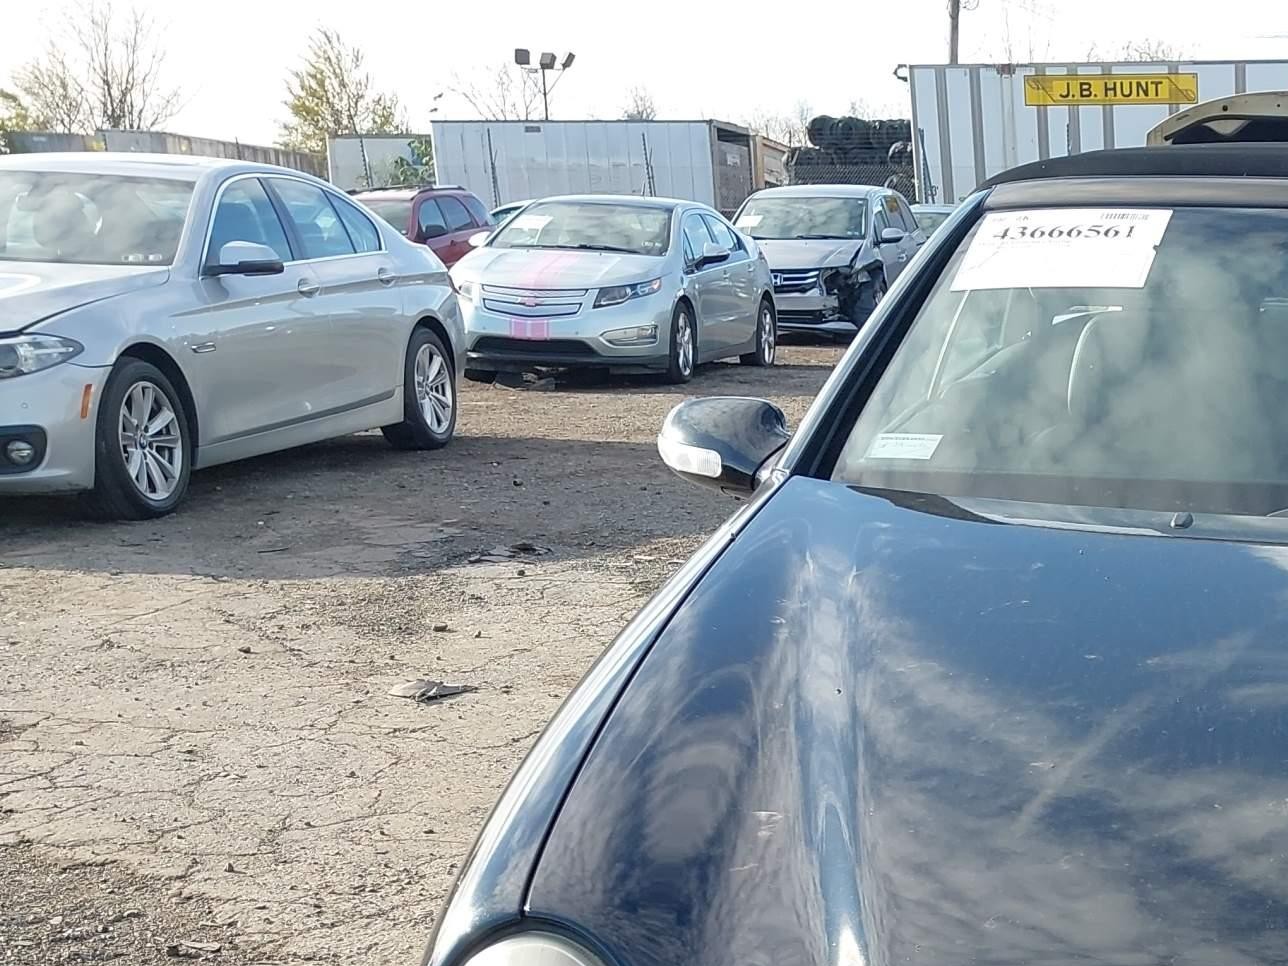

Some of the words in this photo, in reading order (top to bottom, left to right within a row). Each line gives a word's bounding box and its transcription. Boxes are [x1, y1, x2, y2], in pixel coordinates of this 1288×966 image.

[1059, 82, 1098, 99] J.B.
[1104, 81, 1163, 98] HUNT
[992, 225, 1136, 241] 43666561
